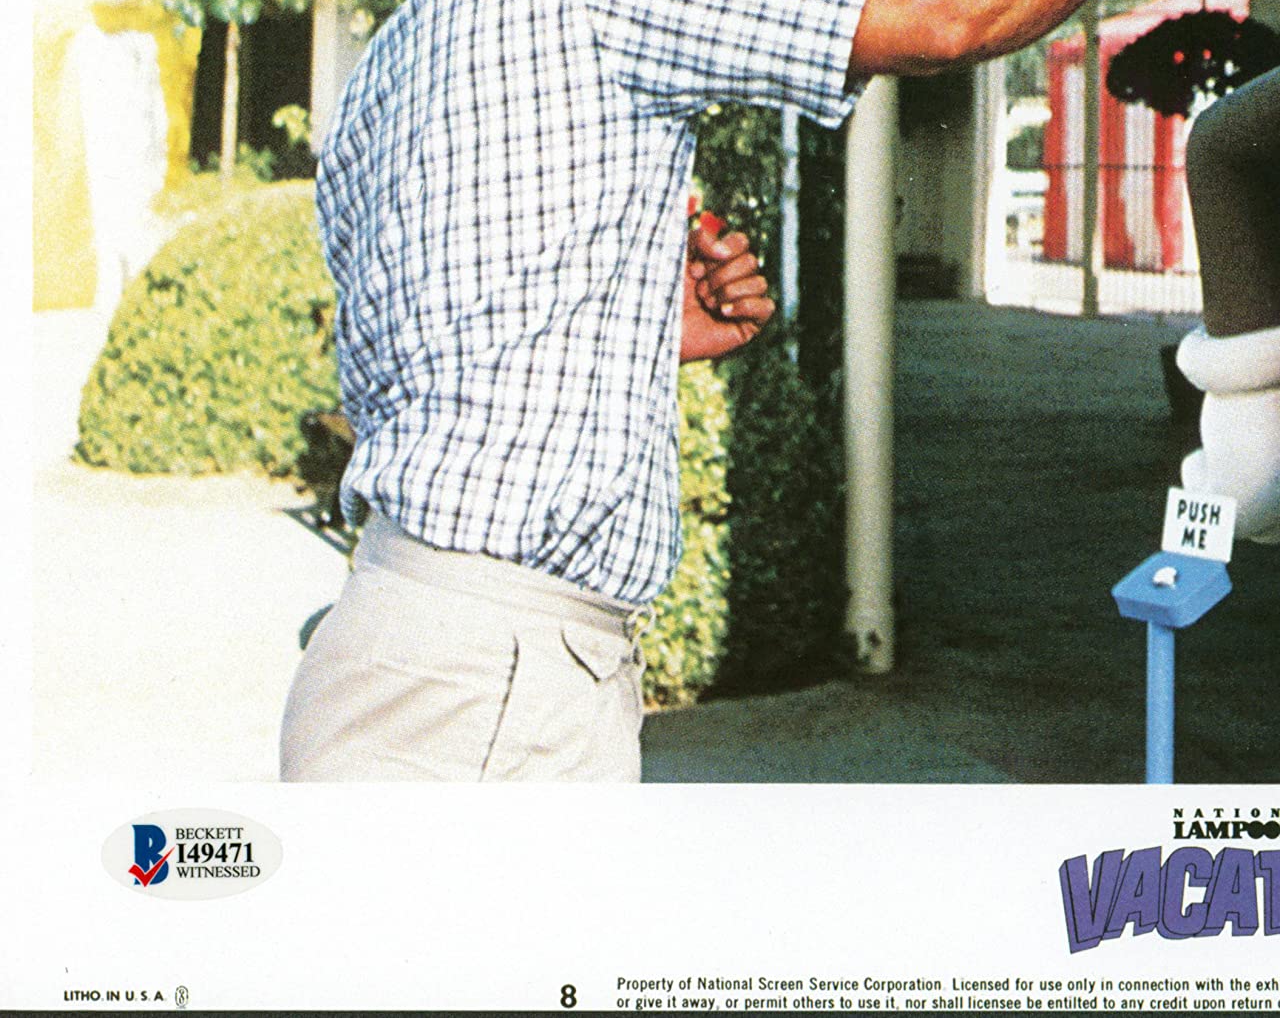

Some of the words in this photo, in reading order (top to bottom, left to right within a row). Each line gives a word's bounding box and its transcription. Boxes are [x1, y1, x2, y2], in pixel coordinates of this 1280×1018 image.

[1177, 498, 1222, 526] PUSH
[1181, 527, 1208, 550] ME
[175, 827, 244, 840] BECKETT
[176, 865, 261, 879] WITNESSED
[617, 976, 674, 993] Property
[678, 977, 692, 991] of
[697, 977, 753, 991] National
[758, 976, 804, 991] Screen
[809, 977, 859, 991] Service
[952, 977, 1010, 992] Licensed
[1015, 977, 1034, 991] for
[1039, 980, 1063, 992] use
[1067, 977, 1096, 994] only
[1100, 980, 1113, 991] in
[1118, 978, 1190, 992] connection
[1195, 977, 1224, 991] with
[1229, 977, 1251, 992] the
[559, 983, 578, 1009] 8
[616, 997, 631, 1009] or
[635, 997, 663, 1010] give
[667, 995, 677, 1009] it
[725, 998, 739, 1009] or
[744, 996, 788, 1010] permit
[792, 995, 835, 1009] others
[839, 996, 853, 1010] to
[857, 998, 881, 1010] use
[905, 998, 927, 1010] nor
[931, 995, 964, 1010] shall
[967, 995, 1022, 1010] licensee
[1026, 996, 1043, 1010] be
[1102, 996, 1116, 1010] to
[1120, 998, 1145, 1010] any
[1149, 996, 1188, 1010] credit
[1193, 998, 1226, 1010] upon
[1231, 996, 1273, 1010] return
